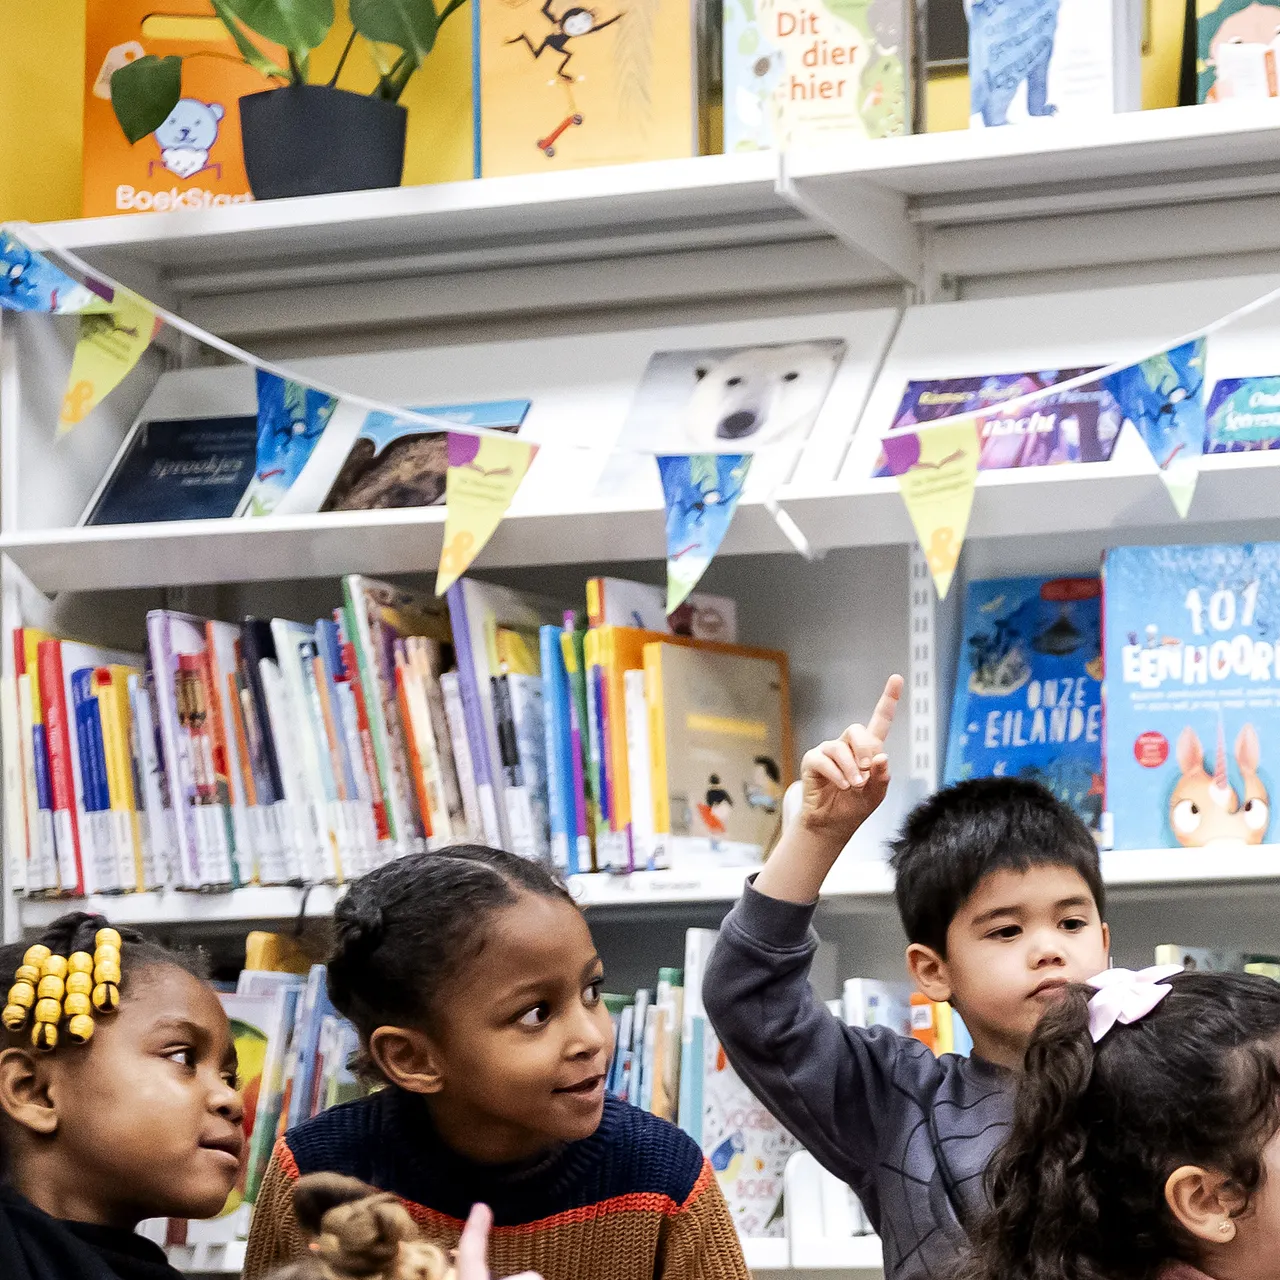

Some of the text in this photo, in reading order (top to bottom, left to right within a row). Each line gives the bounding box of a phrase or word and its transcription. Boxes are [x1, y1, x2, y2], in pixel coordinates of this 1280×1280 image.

[777, 9, 820, 37] Dit
[802, 40, 858, 67] dier
[791, 74, 847, 100] hier
[1184, 577, 1261, 635] 101
[1027, 677, 1088, 710] ONZE
[984, 704, 1100, 749] EILANDE
